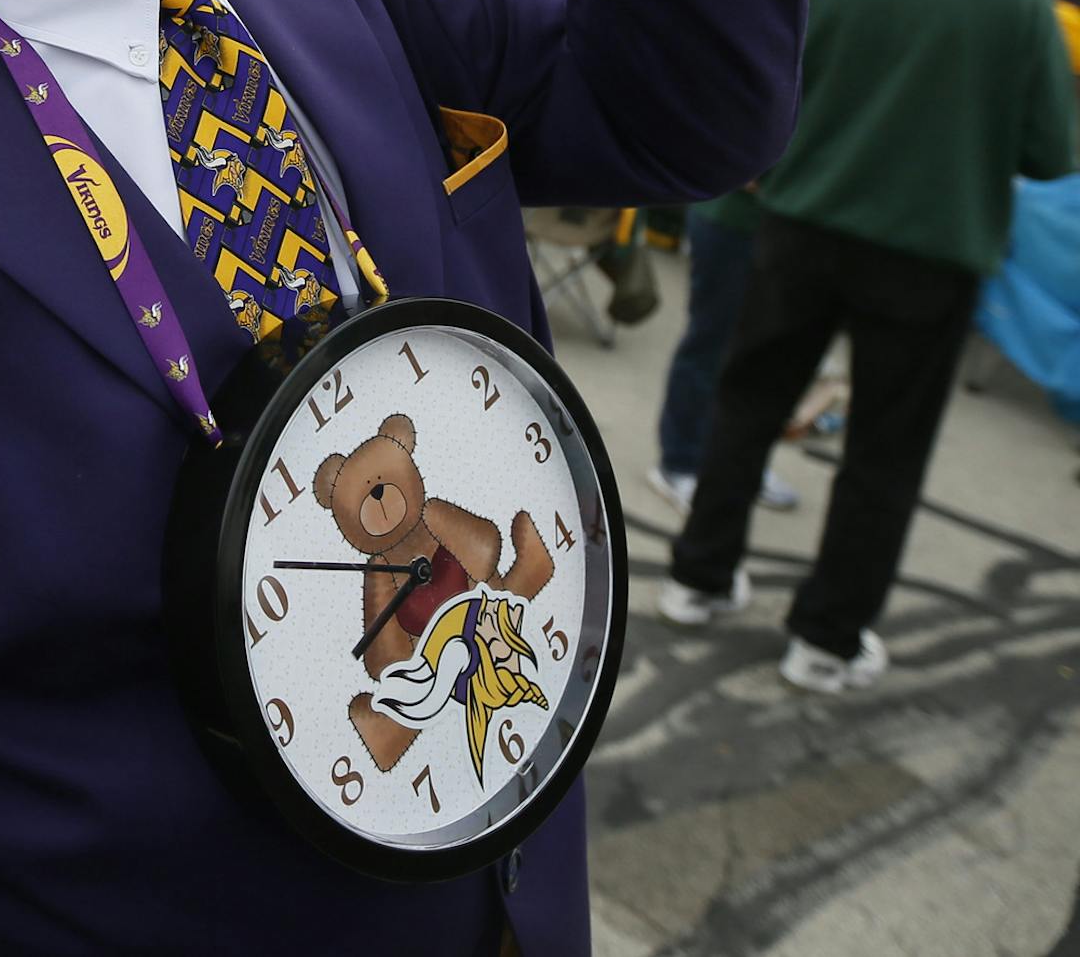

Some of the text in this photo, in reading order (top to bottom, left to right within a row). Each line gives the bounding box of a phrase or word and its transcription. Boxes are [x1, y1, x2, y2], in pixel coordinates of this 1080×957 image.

[66, 163, 113, 240] VIKINGS
[398, 341, 430, 385] 1
[471, 365, 502, 411] 2
[307, 368, 354, 433] 12
[525, 422, 552, 464] 3
[258, 456, 307, 527] 11
[555, 510, 577, 554] 4
[244, 574, 289, 649] 10
[542, 616, 570, 662] 5
[265, 697, 295, 748] 9
[498, 719, 525, 765] 6
[331, 755, 365, 807] 8
[412, 764, 442, 814] 7
